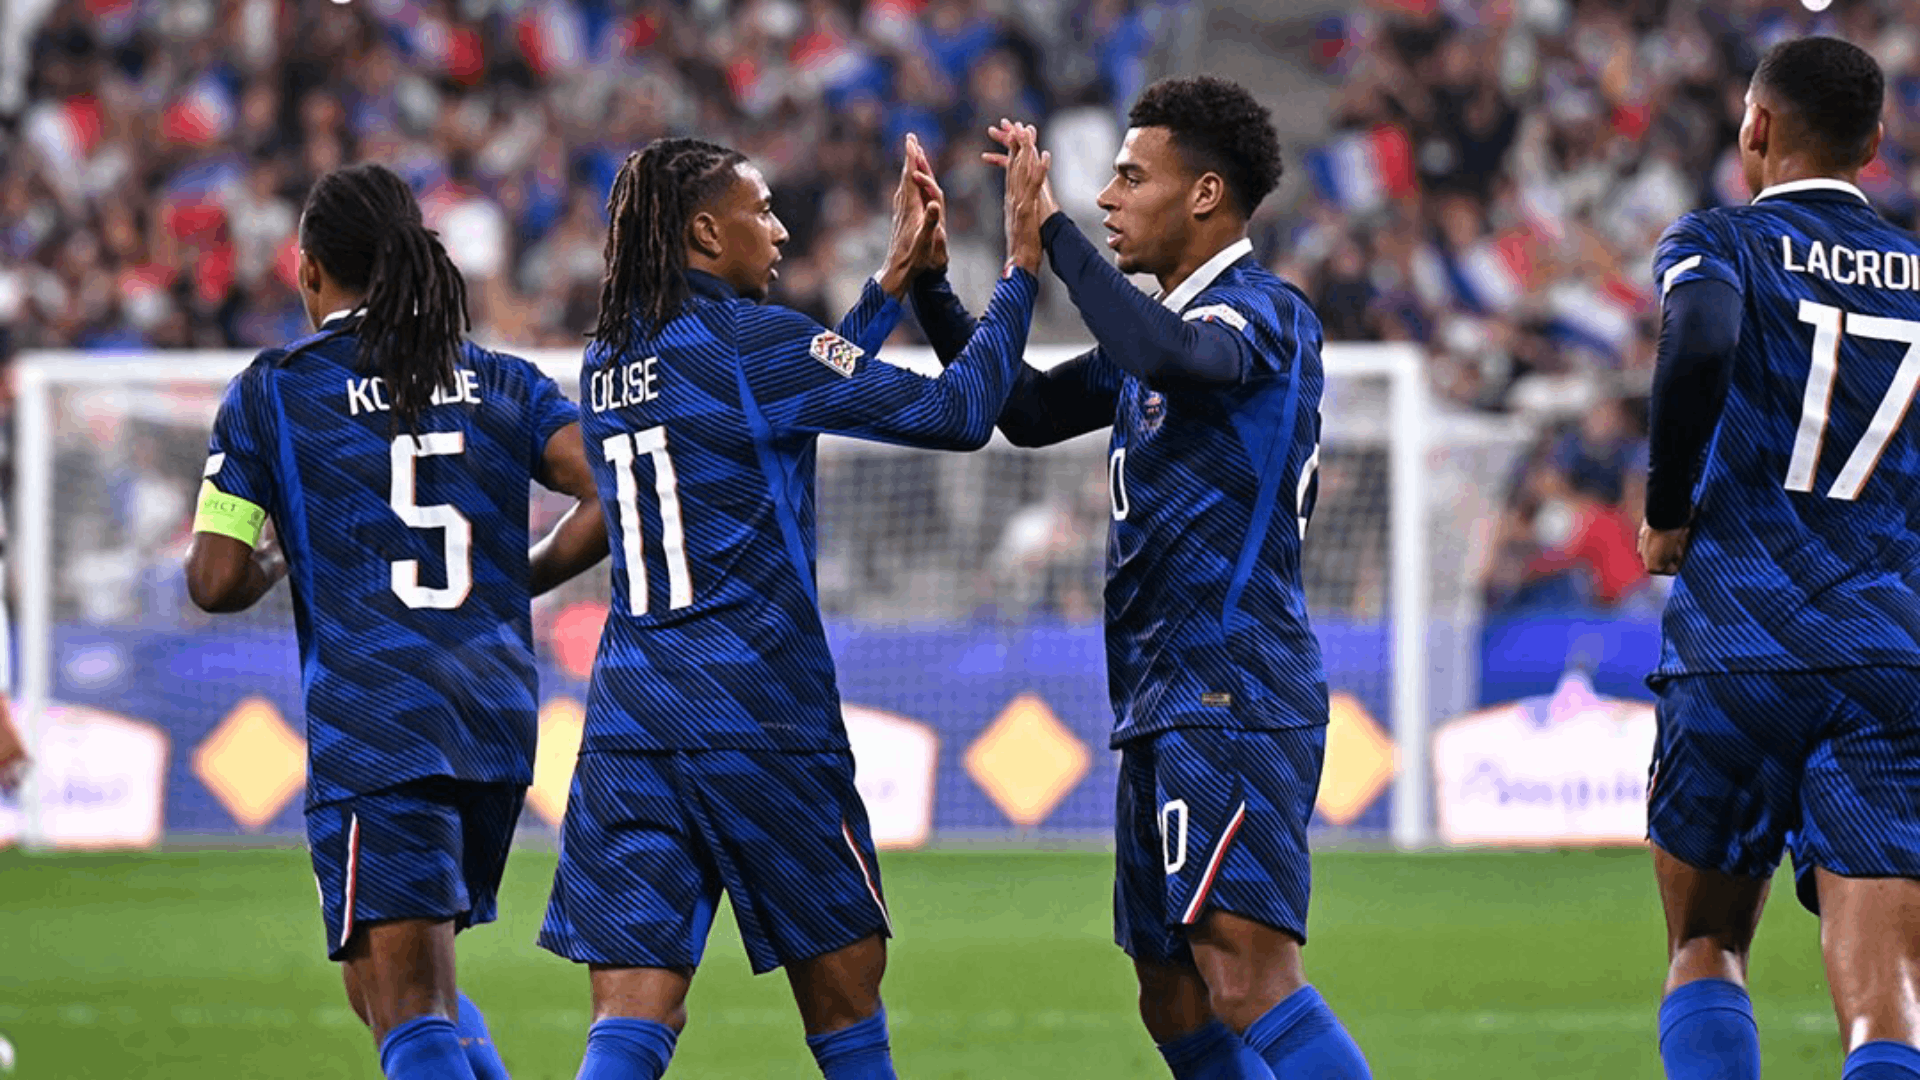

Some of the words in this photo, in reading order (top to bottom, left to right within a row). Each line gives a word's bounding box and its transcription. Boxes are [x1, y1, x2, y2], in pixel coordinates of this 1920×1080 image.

[1782, 235, 1920, 291] LACROI
[591, 356, 659, 413] OLISE
[1784, 299, 1920, 500] 17
[390, 431, 472, 609] 5
[602, 425, 693, 616] 11
